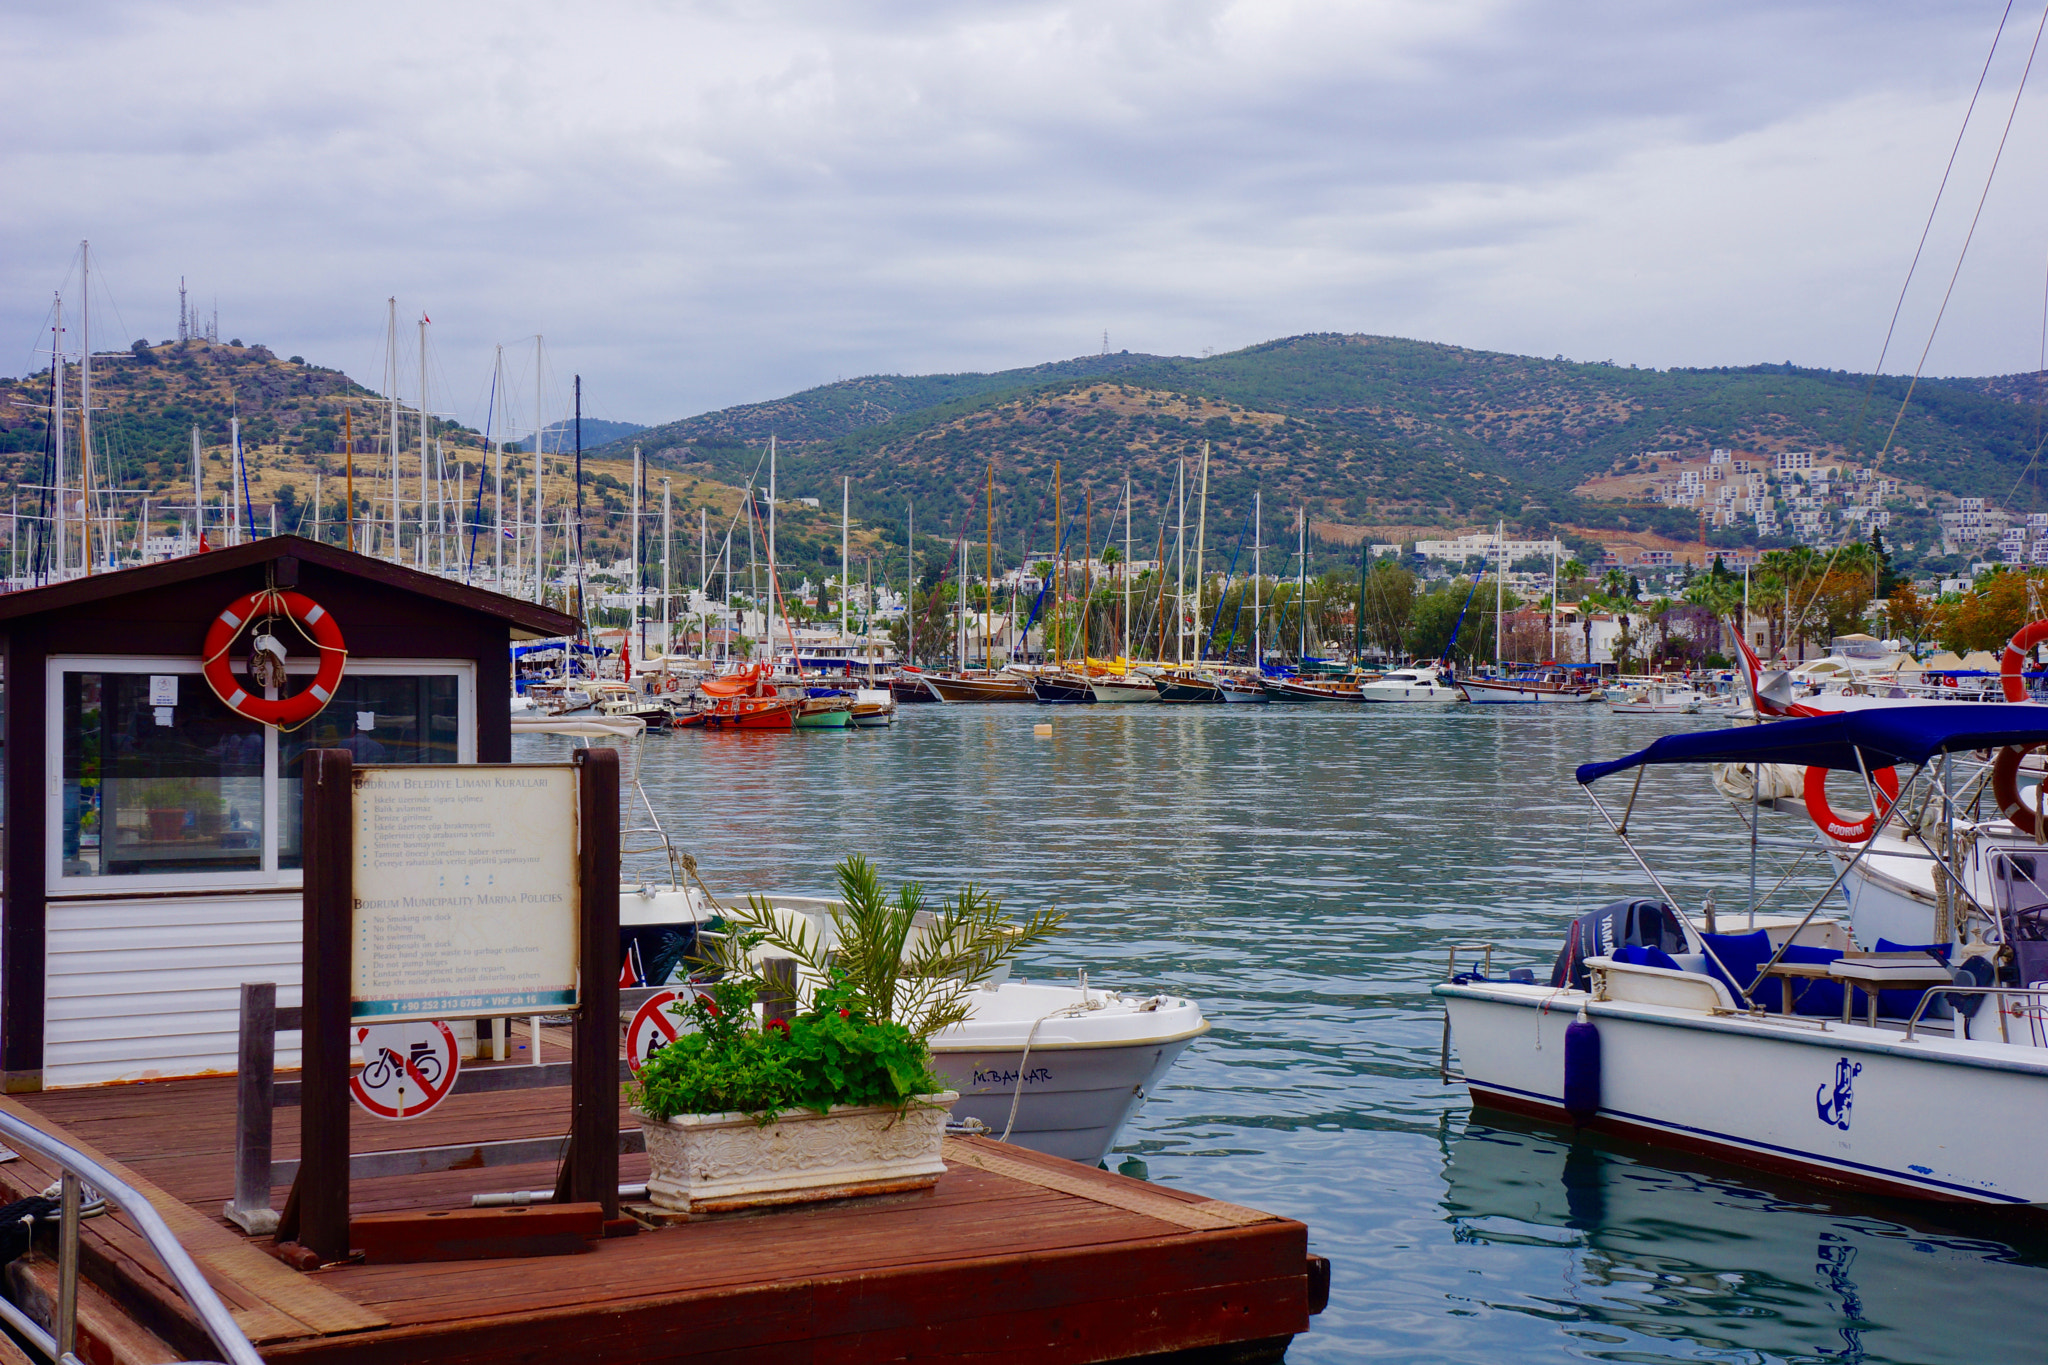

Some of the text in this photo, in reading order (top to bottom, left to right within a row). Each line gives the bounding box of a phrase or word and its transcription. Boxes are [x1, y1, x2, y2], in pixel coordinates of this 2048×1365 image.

[355, 779, 400, 790] BODRUM
[495, 777, 548, 788] KURALLARI
[1828, 822, 1865, 836] BODRUM
[354, 892, 563, 910] BODRUM MUNICIPALITY MARINA POLICIES
[387, 914, 420, 923] Smoking
[434, 913, 451, 921] dock
[387, 924, 413, 933] fishing
[1602, 913, 1614, 956] YAMA
[374, 933, 426, 942] No swimming
[374, 943, 385, 951] No
[399, 950, 418, 959] hand
[419, 951, 437, 959] your
[474, 947, 502, 957] garbage
[505, 945, 540, 954] collectors
[373, 961, 384, 969] Do
[386, 960, 399, 968] not
[402, 960, 424, 969] pump
[373, 979, 391, 988] Keep
[518, 971, 541, 980] others
[474, 986, 520, 996] INFORMATION
[522, 985, 536, 993] AND
[392, 995, 537, 1012] T +90 252 313 6769 VHF ch 16
